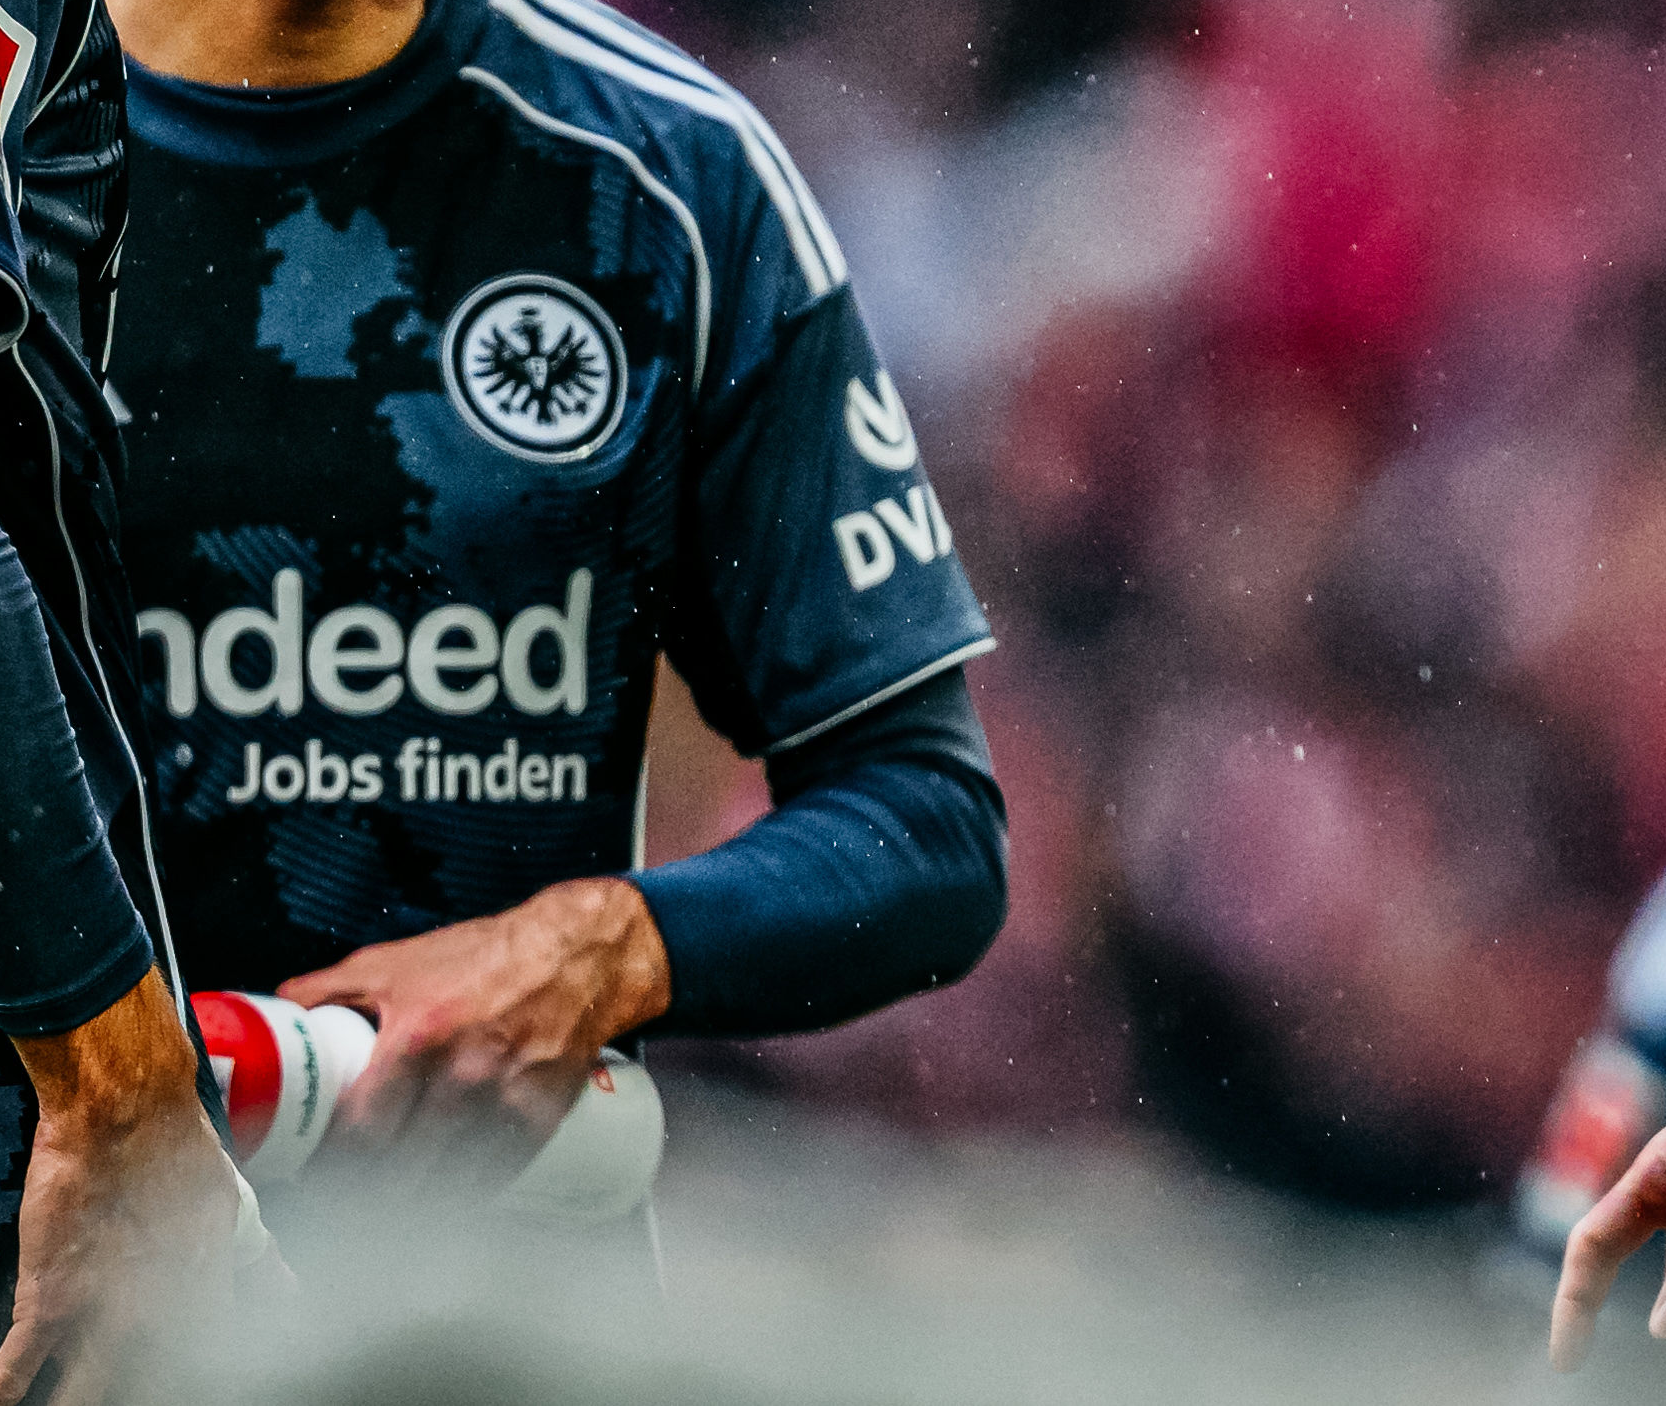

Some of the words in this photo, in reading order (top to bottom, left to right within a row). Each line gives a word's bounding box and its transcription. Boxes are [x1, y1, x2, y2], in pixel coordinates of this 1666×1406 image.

[135, 565, 594, 718] ndeed
[226, 737, 384, 804] Jobs
[395, 736, 588, 803] finden
